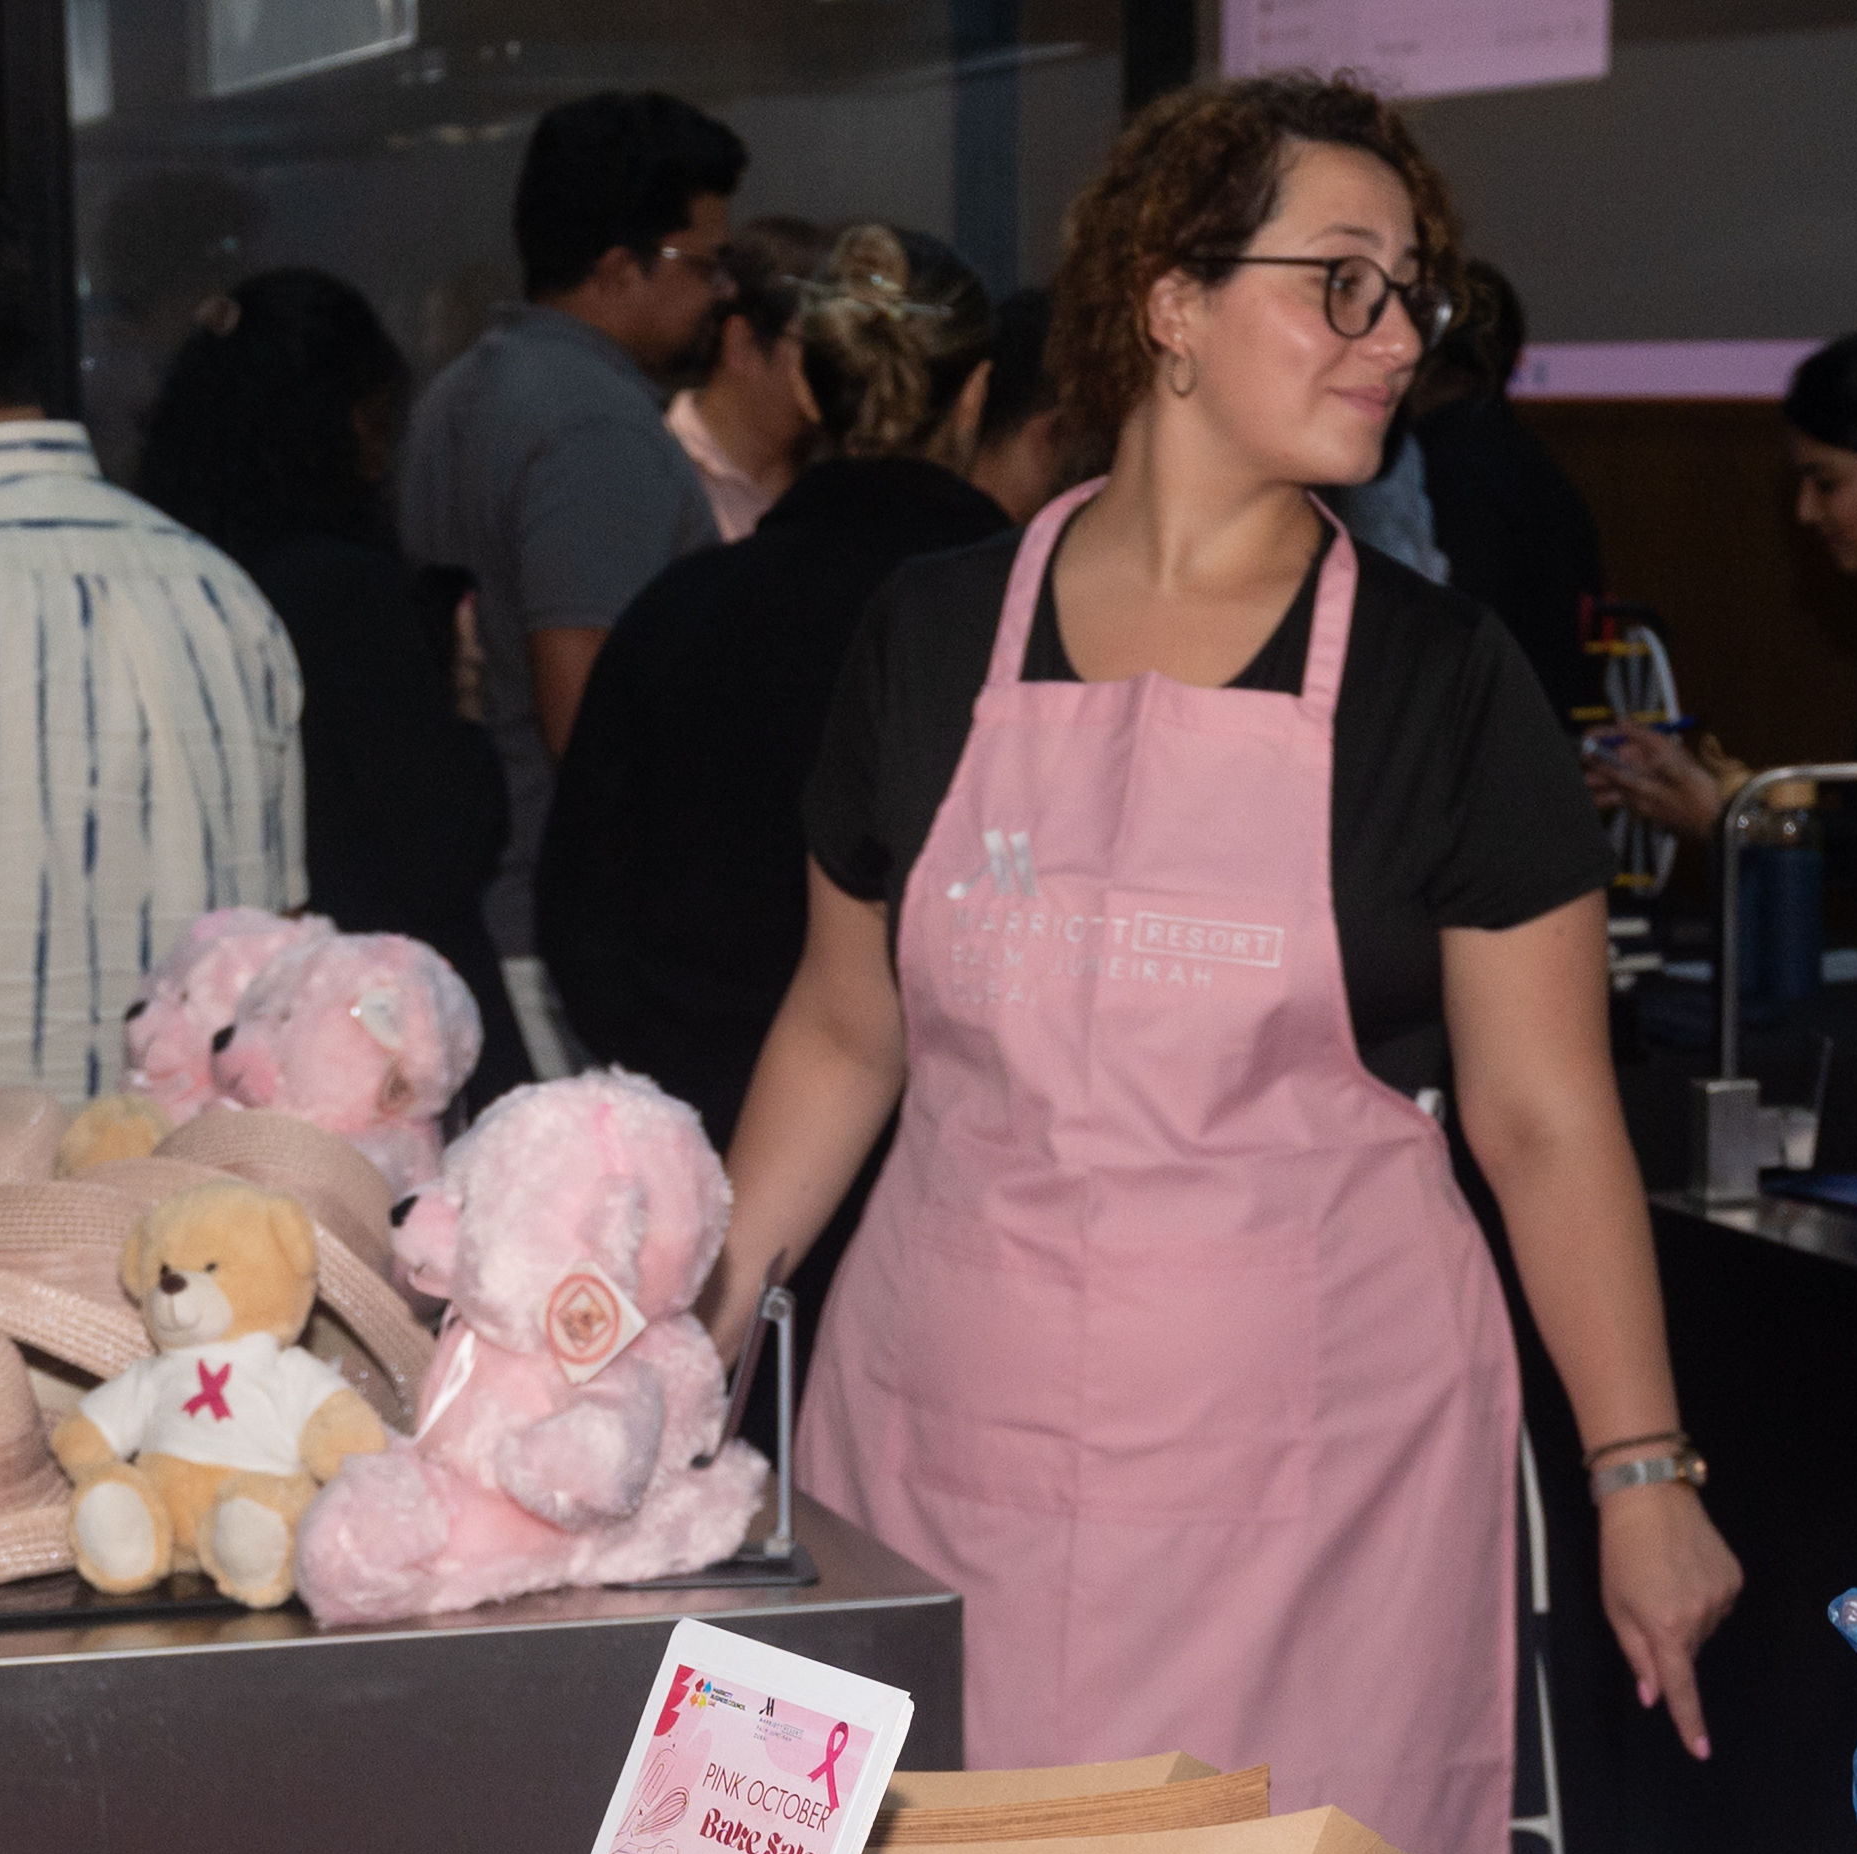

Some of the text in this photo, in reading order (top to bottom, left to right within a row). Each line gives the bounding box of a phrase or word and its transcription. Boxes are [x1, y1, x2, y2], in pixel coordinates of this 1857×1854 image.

[1145, 921, 1272, 957] RESORT
[702, 1762, 832, 1832] PINK OCTOBER
[699, 1808, 761, 1854] Bake
